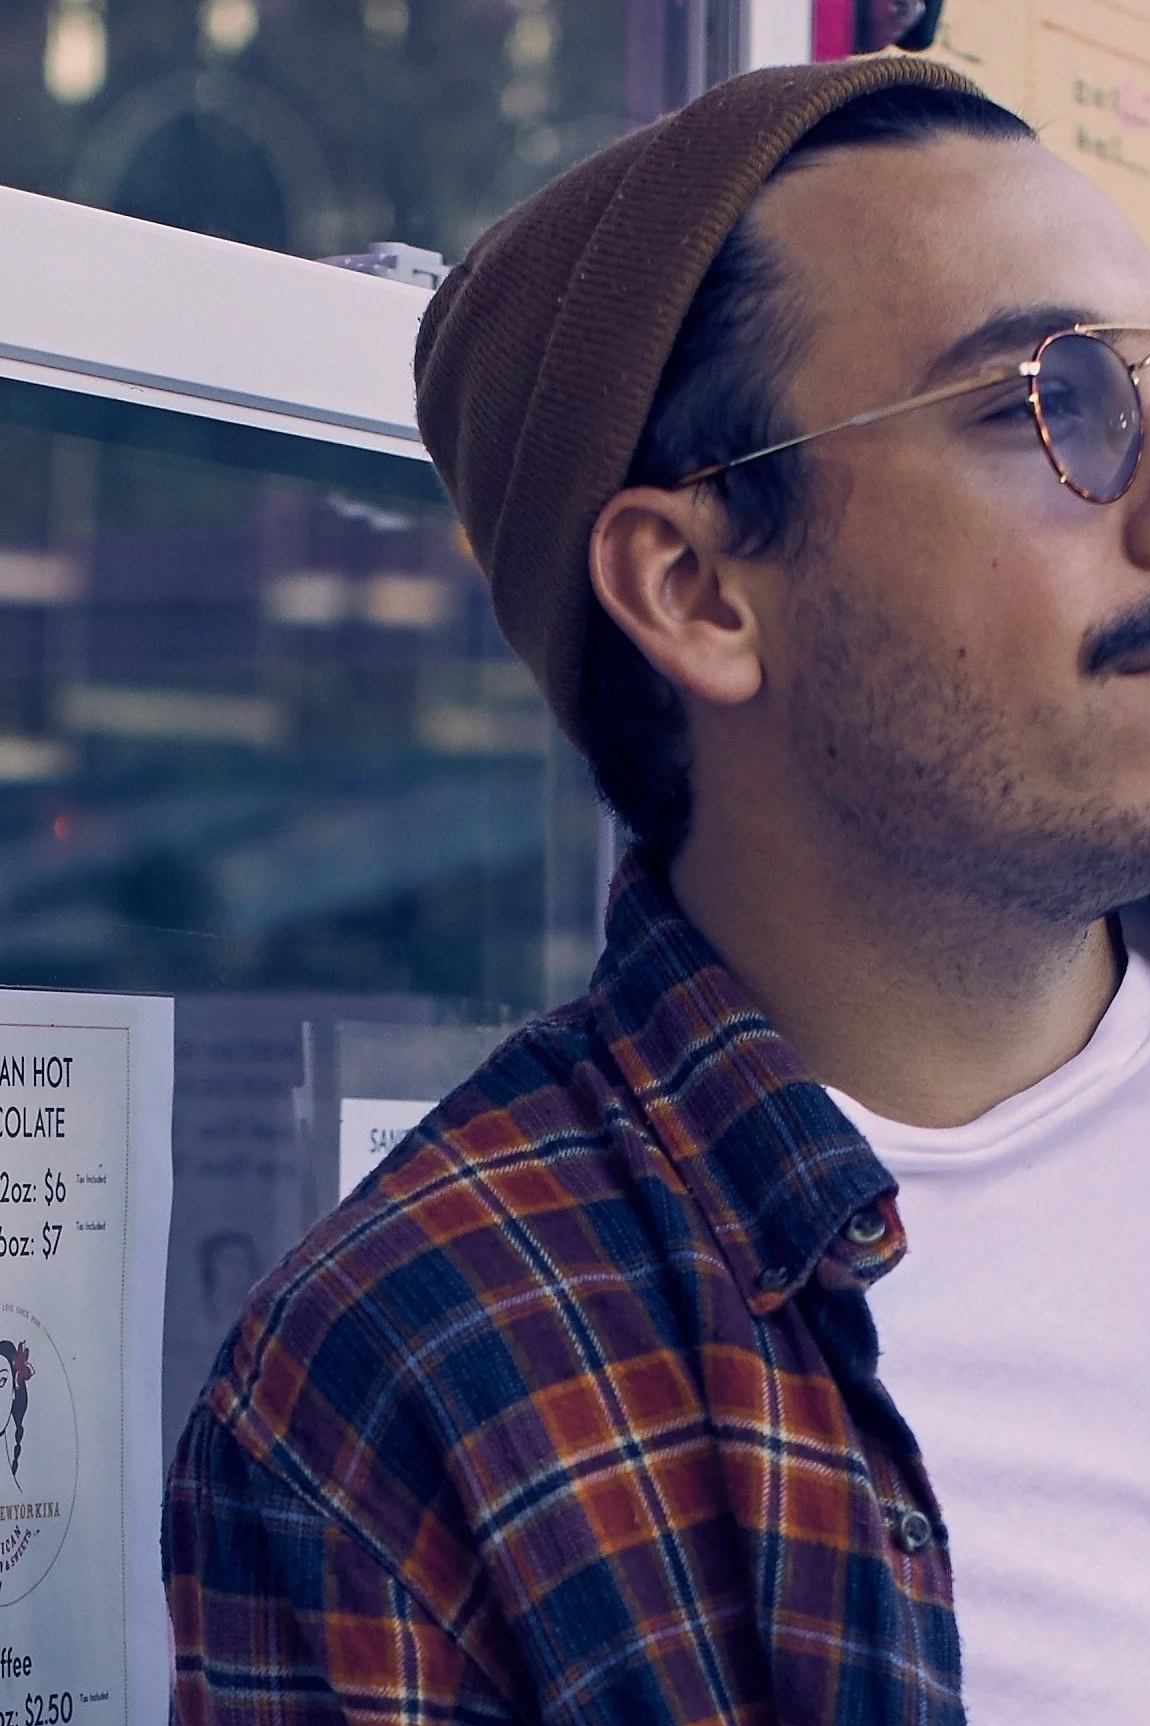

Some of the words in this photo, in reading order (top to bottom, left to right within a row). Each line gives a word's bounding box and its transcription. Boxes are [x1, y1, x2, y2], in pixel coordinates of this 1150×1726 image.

[34, 1056, 73, 1088] HOT
[0, 1106, 66, 1138] OLATE
[44, 1168, 66, 1206] $6
[42, 1221, 63, 1260] $7
[0, 1647, 32, 1679] ffee
